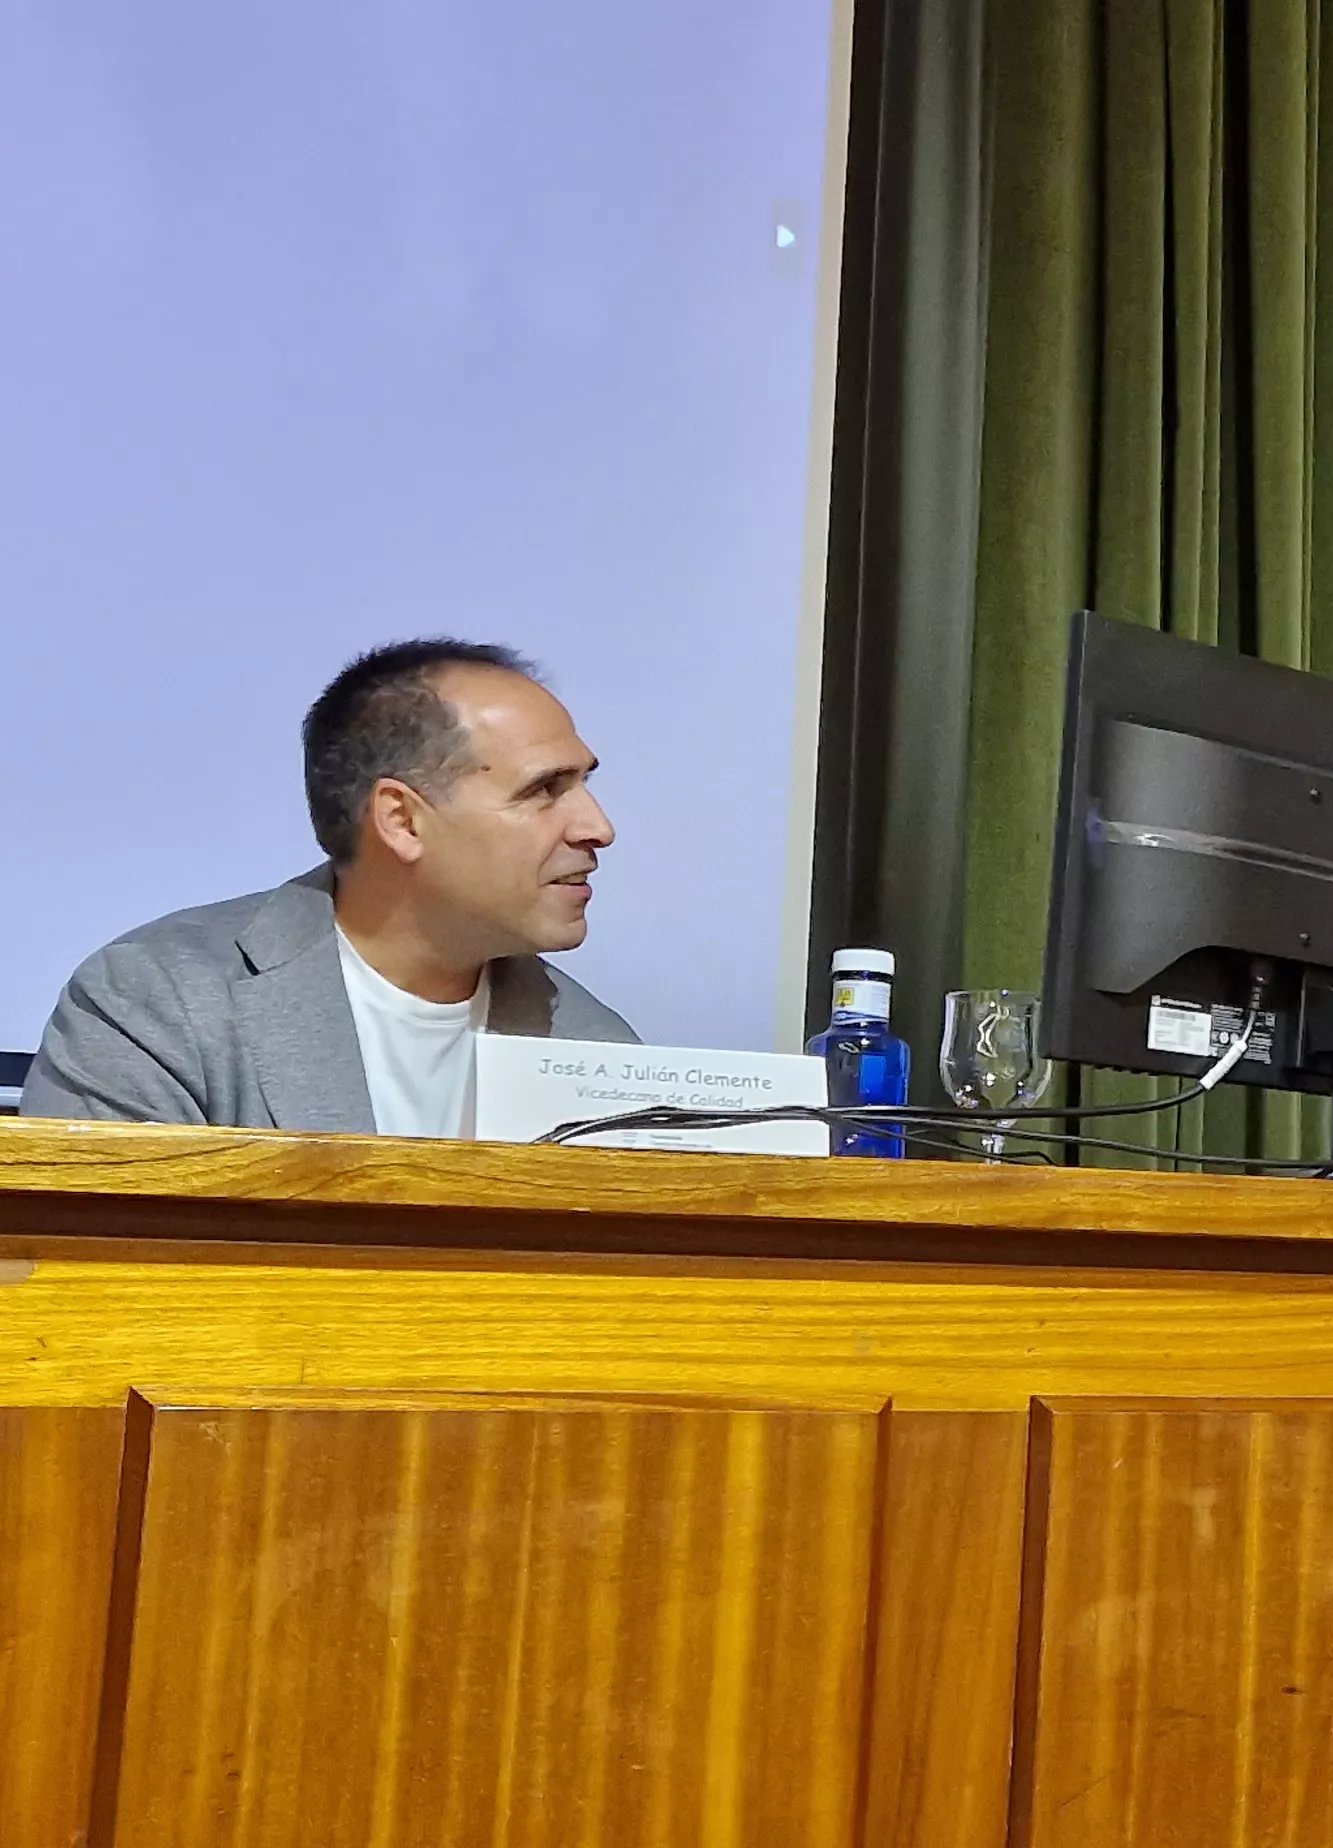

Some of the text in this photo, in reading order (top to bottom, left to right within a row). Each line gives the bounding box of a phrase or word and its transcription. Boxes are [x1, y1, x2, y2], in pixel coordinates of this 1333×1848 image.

[538, 1058, 587, 1077] José
[620, 1064, 679, 1084] Julián
[685, 1069, 774, 1090] Clemente
[575, 1086, 744, 1108] Vicedecano de Calidad
